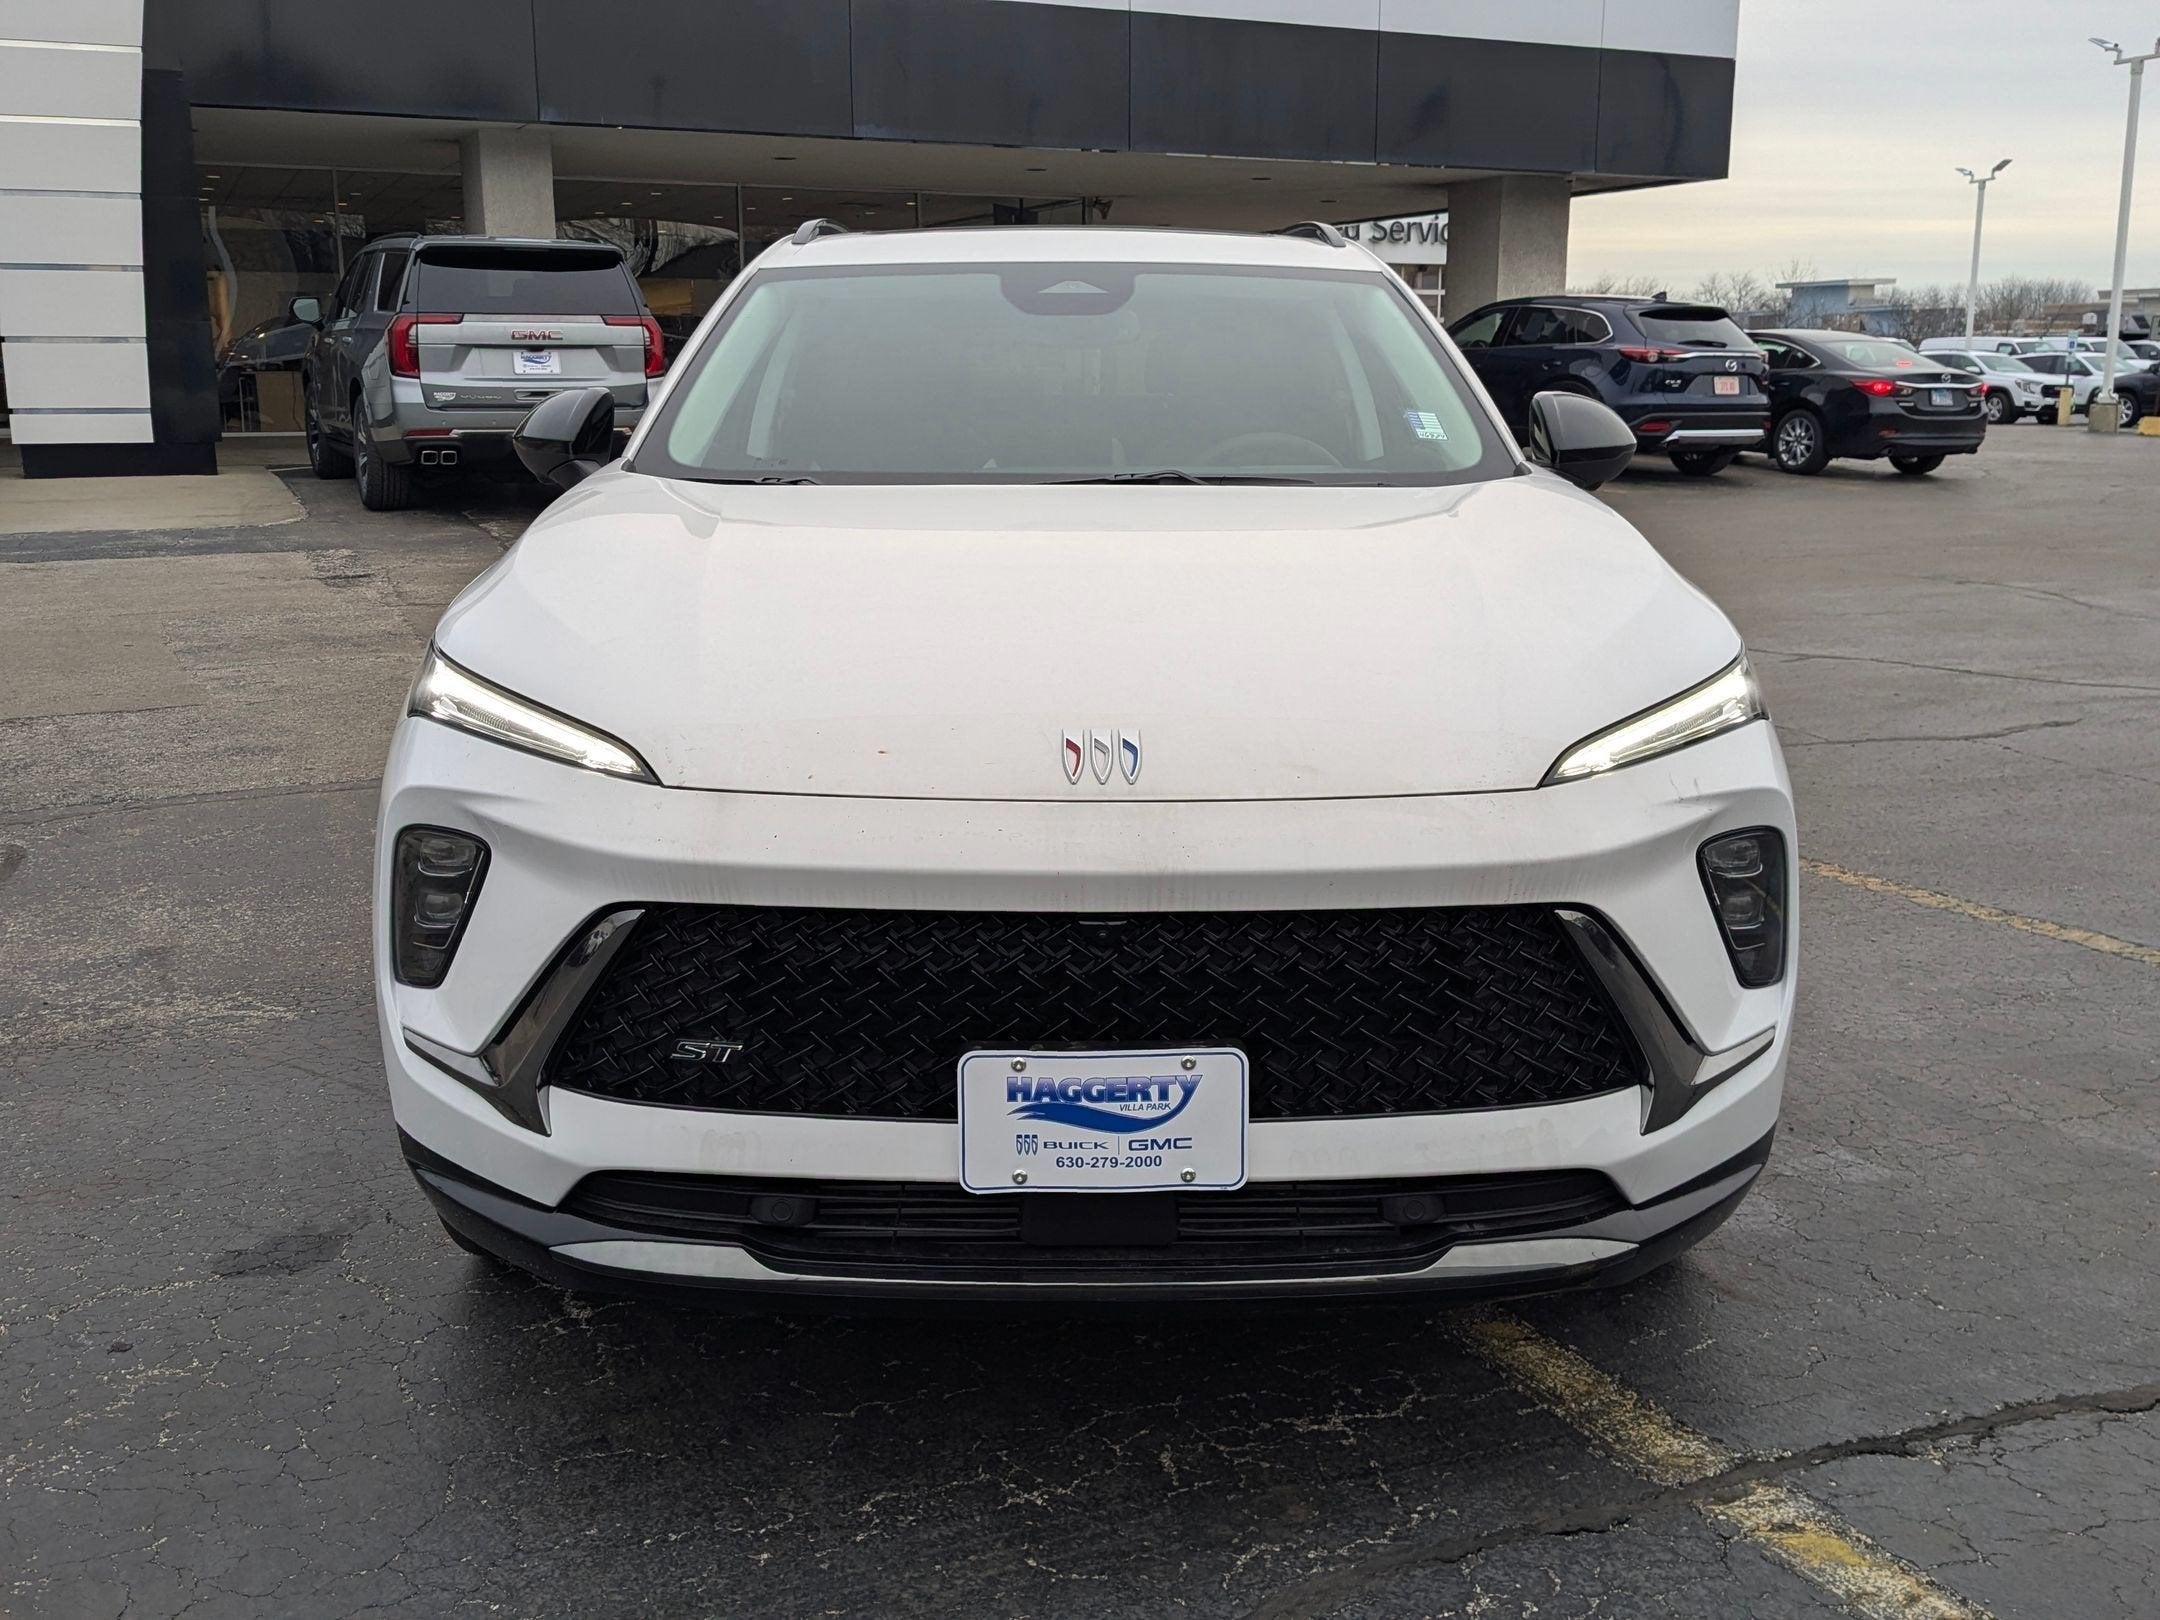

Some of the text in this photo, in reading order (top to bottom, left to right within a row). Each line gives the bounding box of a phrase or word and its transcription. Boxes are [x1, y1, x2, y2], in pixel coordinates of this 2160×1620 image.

[1372, 215, 1448, 242] Servic
[511, 329, 563, 341] GMC
[670, 1040, 743, 1062] ST
[1006, 1074, 1203, 1104] HAGGERTY
[1119, 1102, 1171, 1112] VILLA PARK
[1043, 1137, 1192, 1151] BUICK GMC
[1055, 1155, 1162, 1168] 630-279-2000
